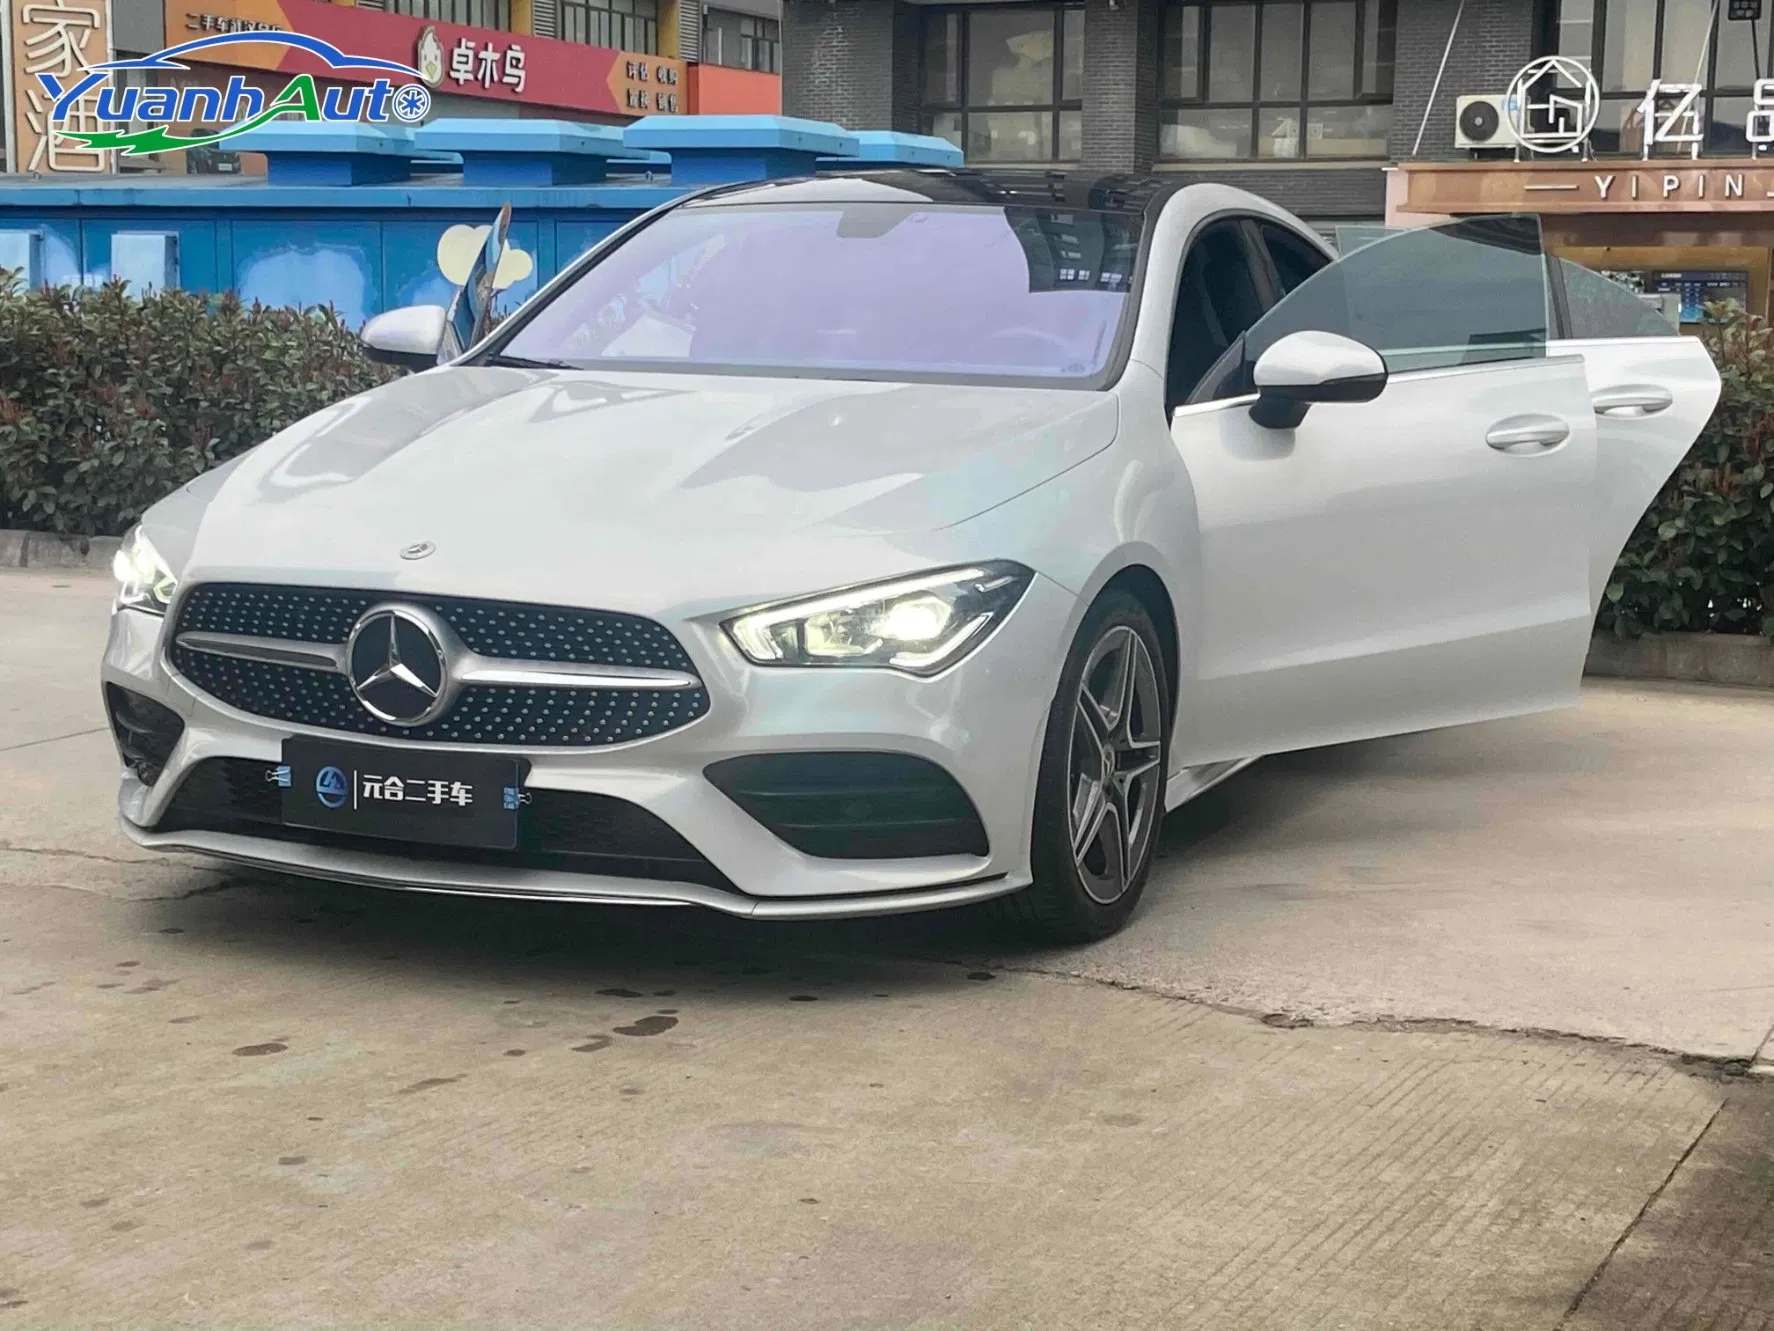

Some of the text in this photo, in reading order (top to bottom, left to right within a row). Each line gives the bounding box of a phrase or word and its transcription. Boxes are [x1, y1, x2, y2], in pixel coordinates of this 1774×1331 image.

[450, 38, 527, 93] 卓木鸟
[1595, 173, 1744, 198] YIPIN
[363, 774, 473, 807] 元合二手车
